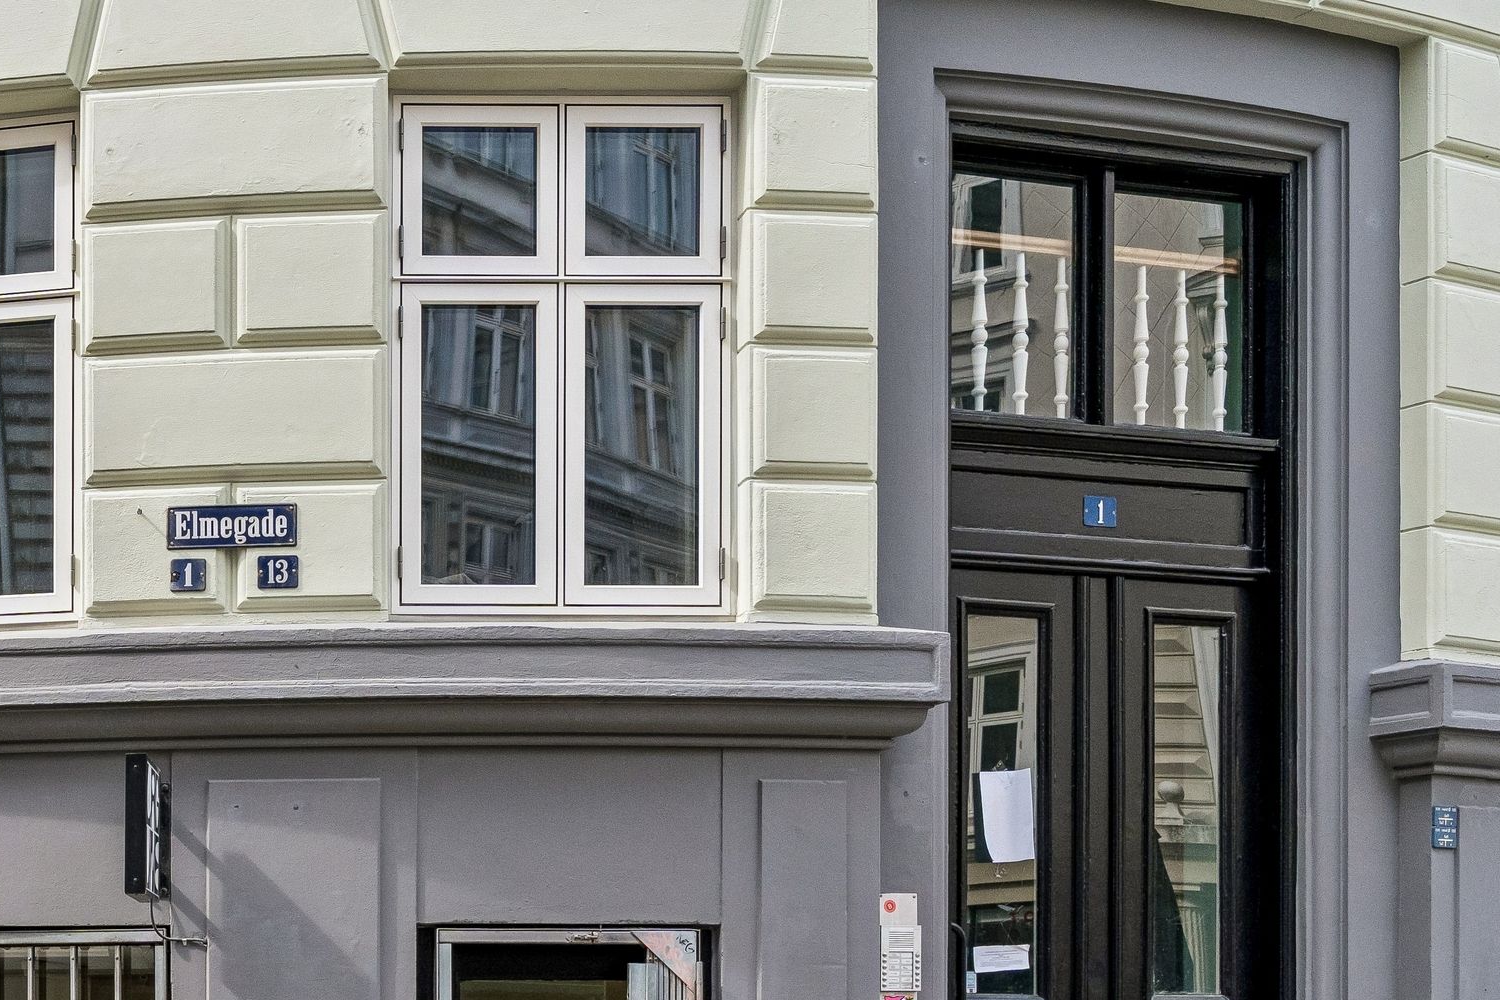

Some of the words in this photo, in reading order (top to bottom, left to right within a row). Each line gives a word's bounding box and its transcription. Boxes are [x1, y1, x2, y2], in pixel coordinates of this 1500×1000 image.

[1098, 500, 1104, 523] 1
[174, 509, 288, 543] Elmegade
[184, 562, 193, 587] 1
[267, 559, 288, 584] 13
